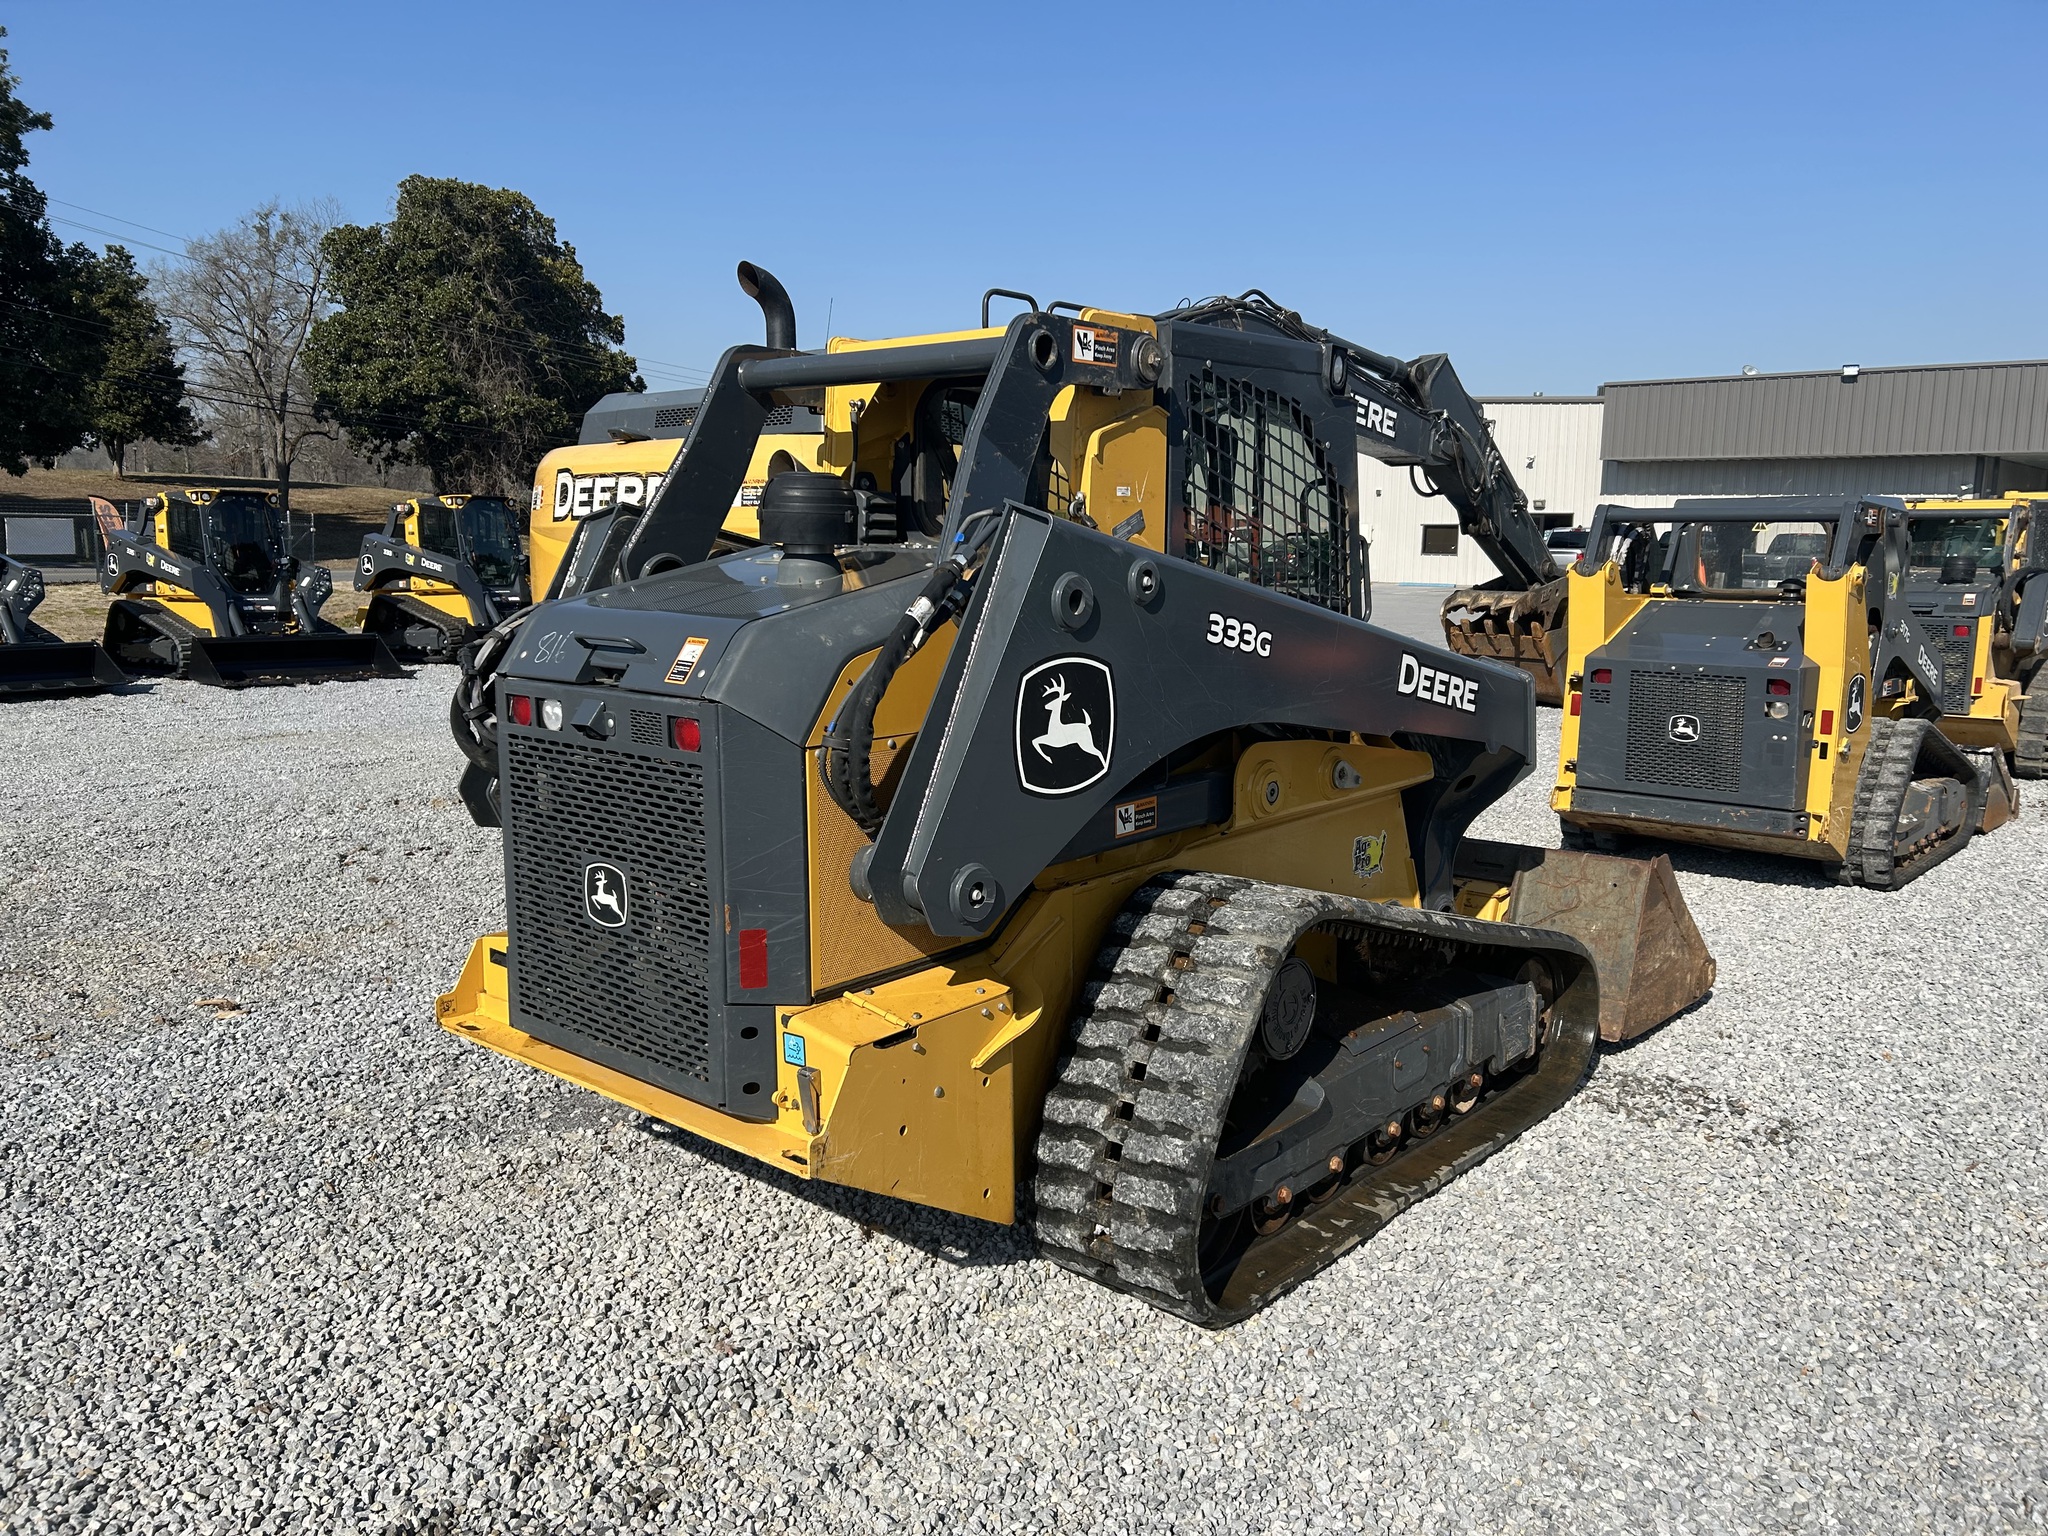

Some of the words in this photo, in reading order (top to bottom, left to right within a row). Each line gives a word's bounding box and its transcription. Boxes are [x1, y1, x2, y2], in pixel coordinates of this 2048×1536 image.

[1350, 392, 1398, 438] ERE
[160, 559, 181, 577] DEERE
[421, 557, 443, 573] DEERE
[1206, 612, 1273, 658] 333G
[1397, 653, 1480, 713] DEERE
[1918, 644, 1939, 686] DEERE
